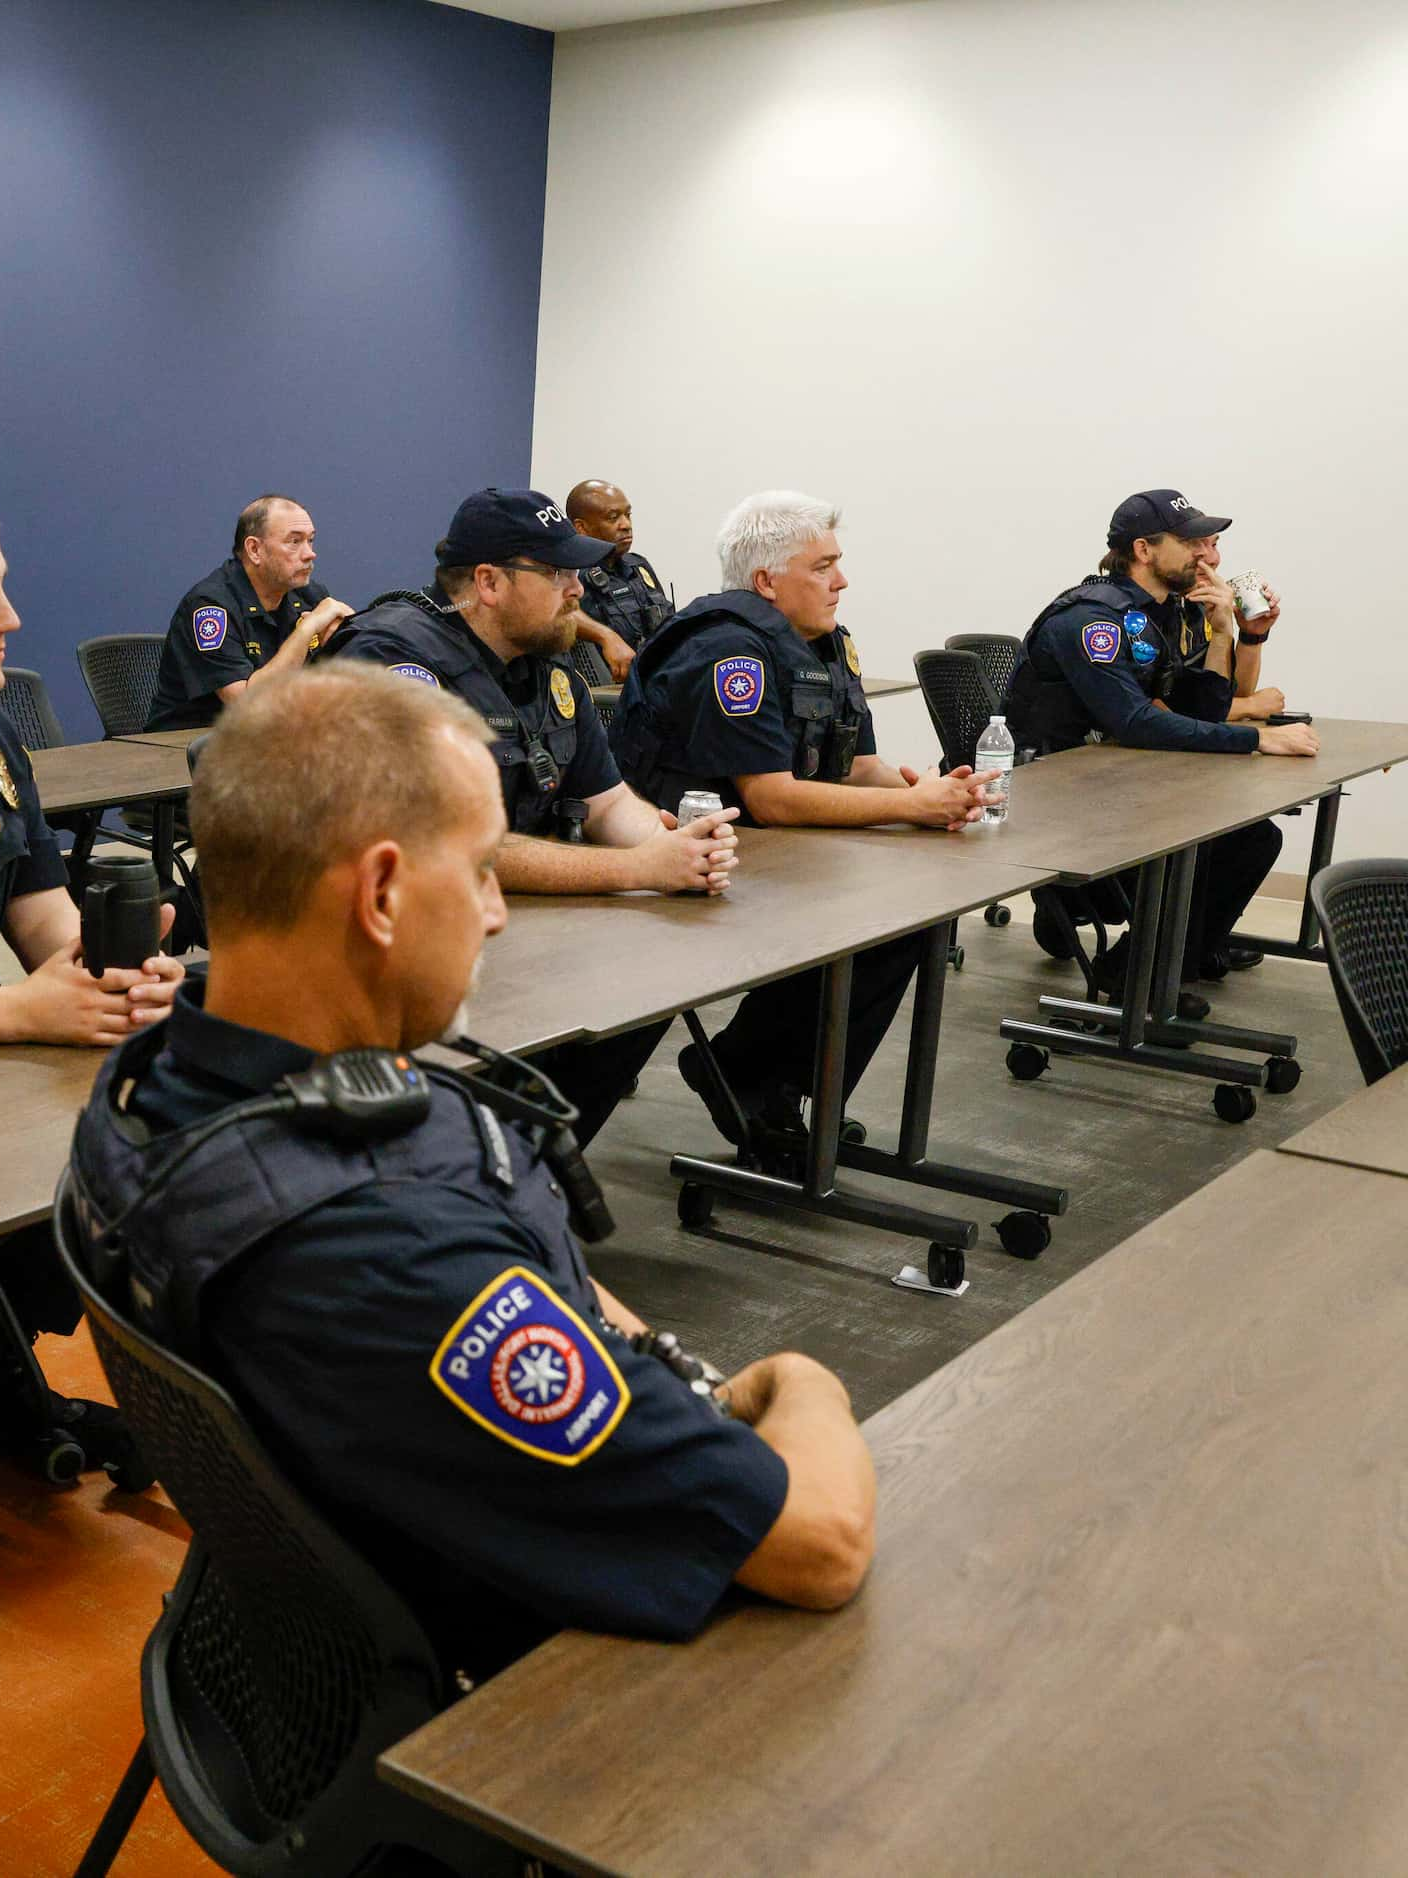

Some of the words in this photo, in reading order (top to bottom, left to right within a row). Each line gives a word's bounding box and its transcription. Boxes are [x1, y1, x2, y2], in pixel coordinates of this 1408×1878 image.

[197, 609, 223, 618] POLICE
[1087, 625, 1116, 633] POLICE
[719, 661, 758, 673] POLICE
[448, 1285, 533, 1380] POLICE
